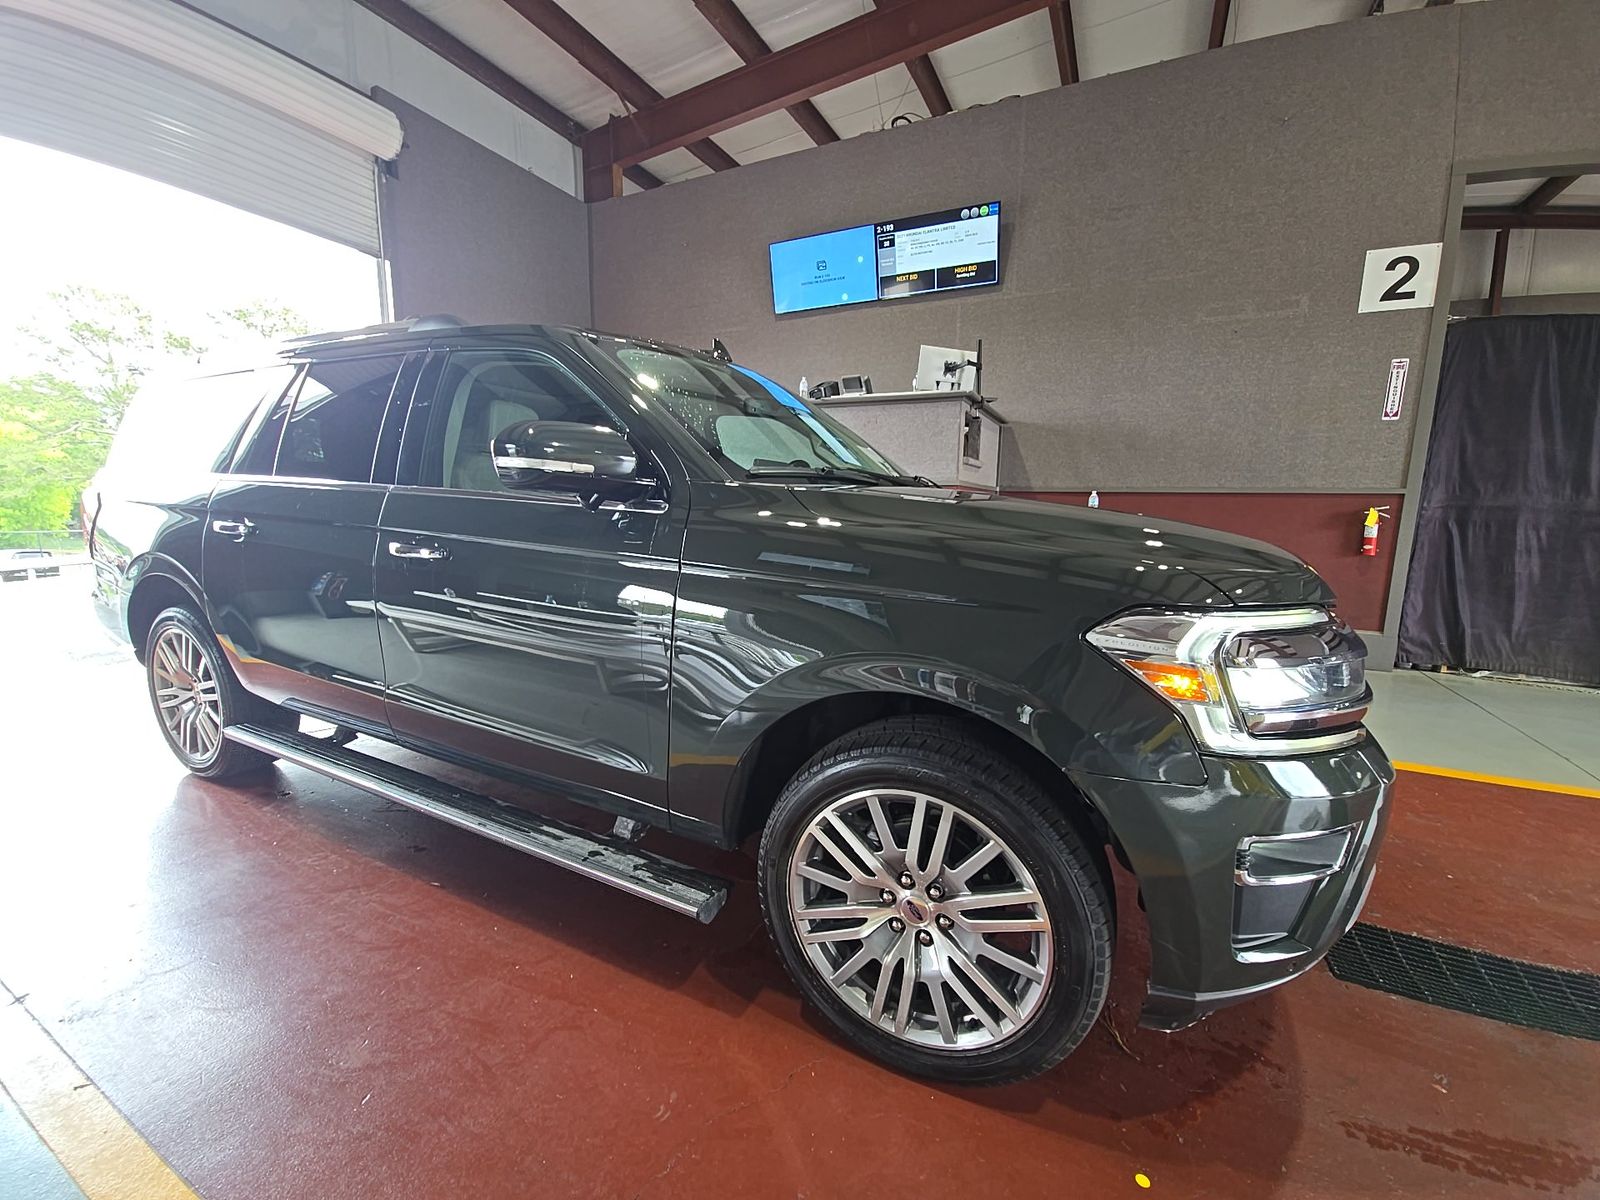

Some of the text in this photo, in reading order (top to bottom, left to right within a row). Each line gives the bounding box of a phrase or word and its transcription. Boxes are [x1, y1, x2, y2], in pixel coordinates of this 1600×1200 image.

[896, 274, 909, 282] NEXT
[954, 265, 968, 274] HIGH
[1379, 255, 1420, 302] 2
[1389, 370, 1400, 414] EXTINGUISHER
